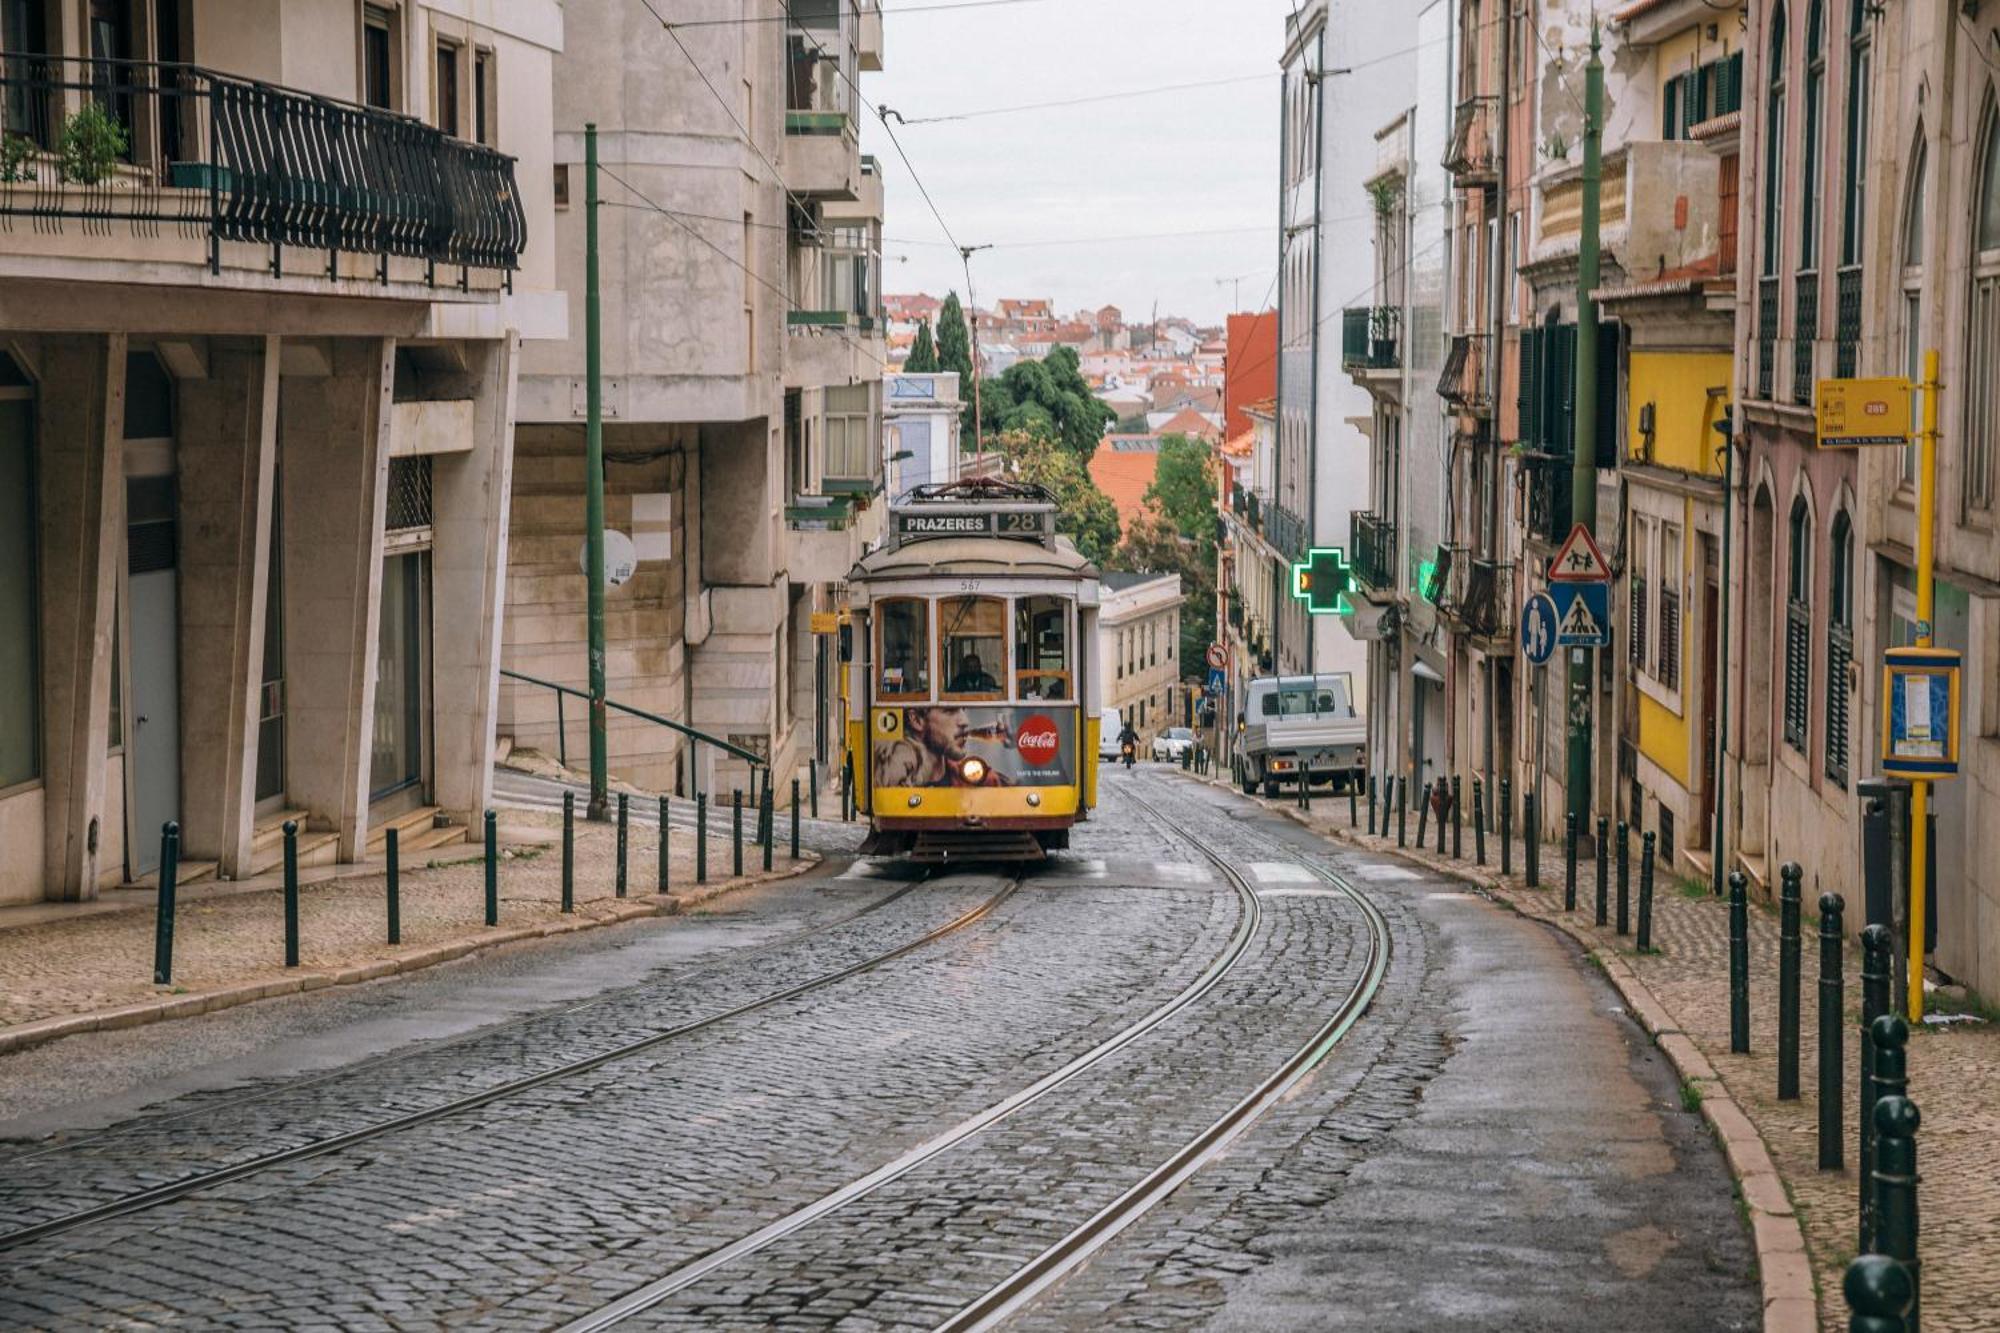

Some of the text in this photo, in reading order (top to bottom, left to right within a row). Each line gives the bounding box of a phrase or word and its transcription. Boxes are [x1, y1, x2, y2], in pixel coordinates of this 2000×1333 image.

[907, 518, 984, 530] PRAZERES
[1007, 513, 1035, 531] 28
[960, 580, 981, 591] 567
